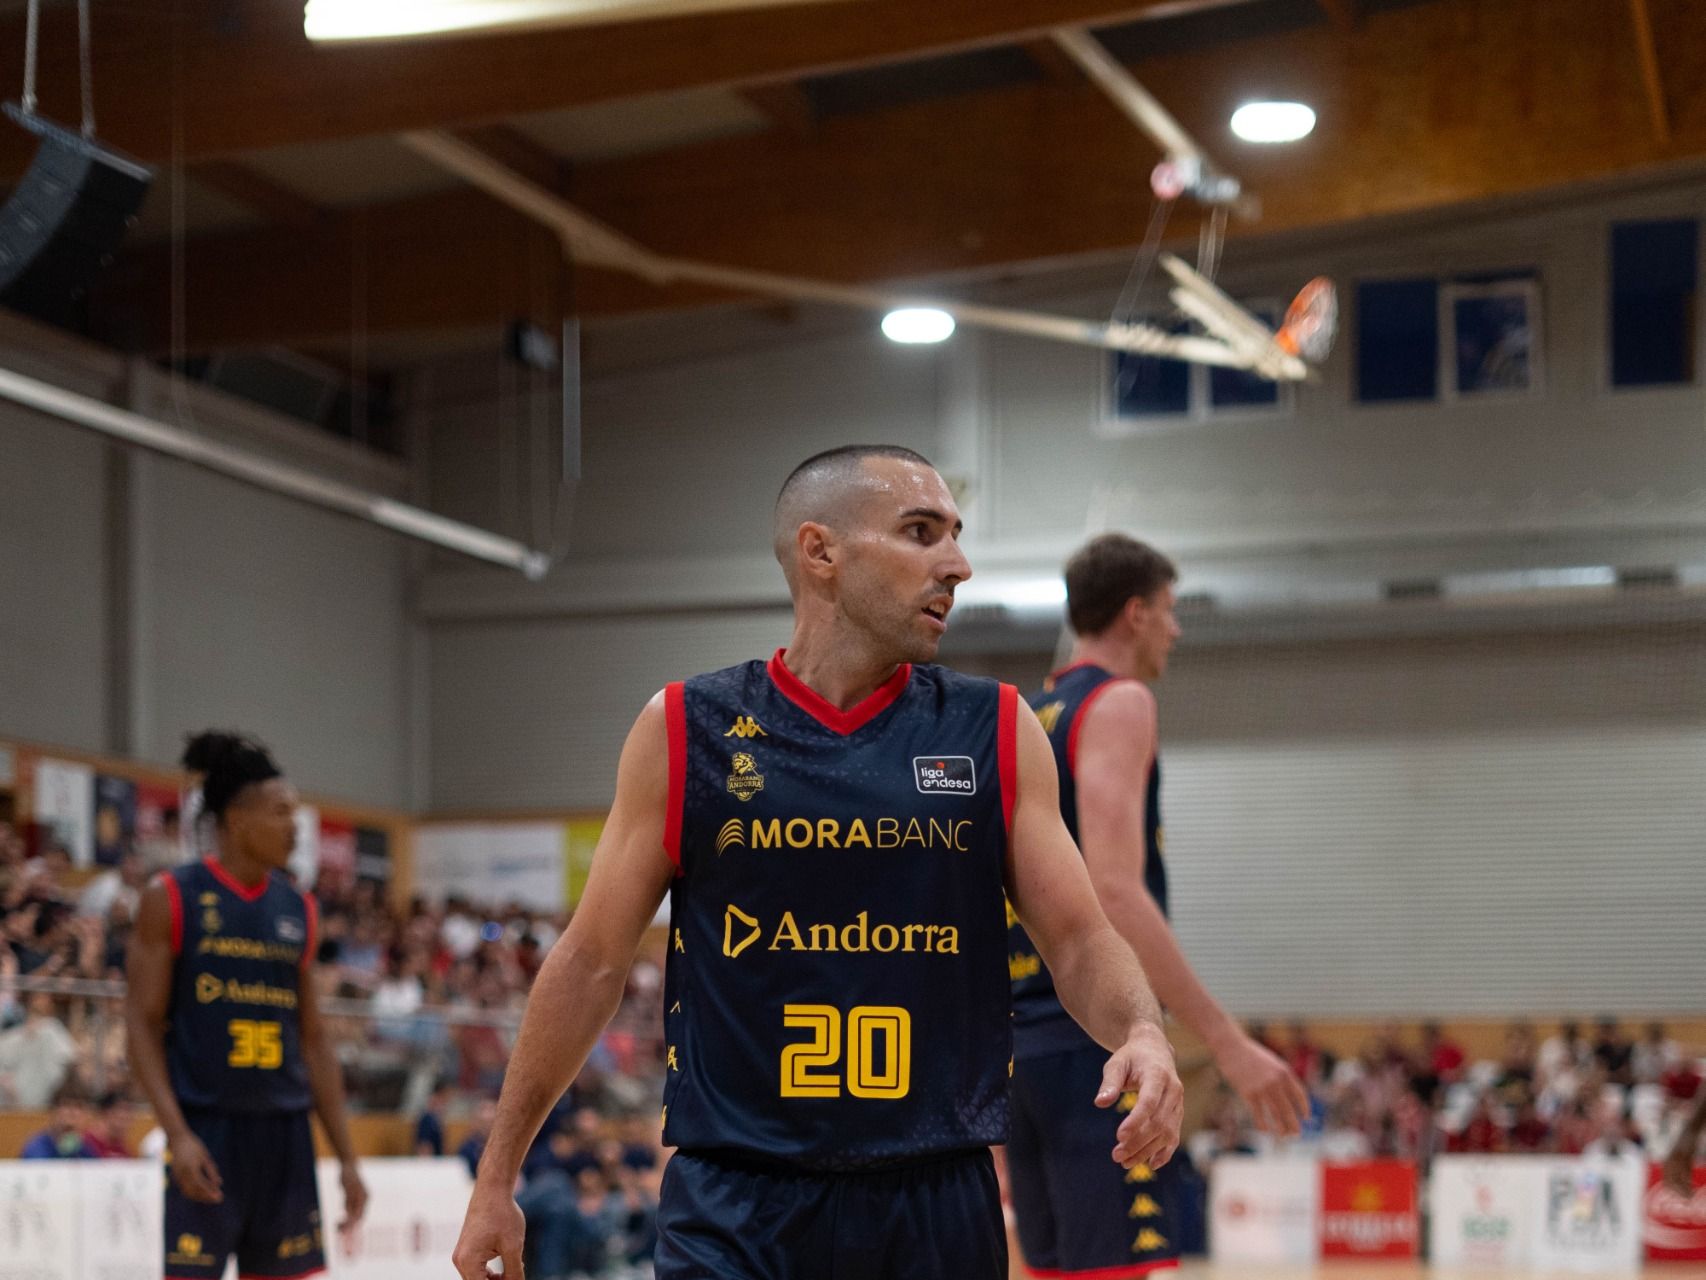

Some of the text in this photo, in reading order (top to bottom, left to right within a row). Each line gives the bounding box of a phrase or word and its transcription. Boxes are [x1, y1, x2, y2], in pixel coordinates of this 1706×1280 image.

[921, 767, 944, 779] liga
[922, 777, 971, 789] endesa
[751, 817, 973, 852] MORABANC
[767, 911, 960, 955] Andorra
[228, 1019, 284, 1069] 35
[780, 1004, 911, 1099] 20
